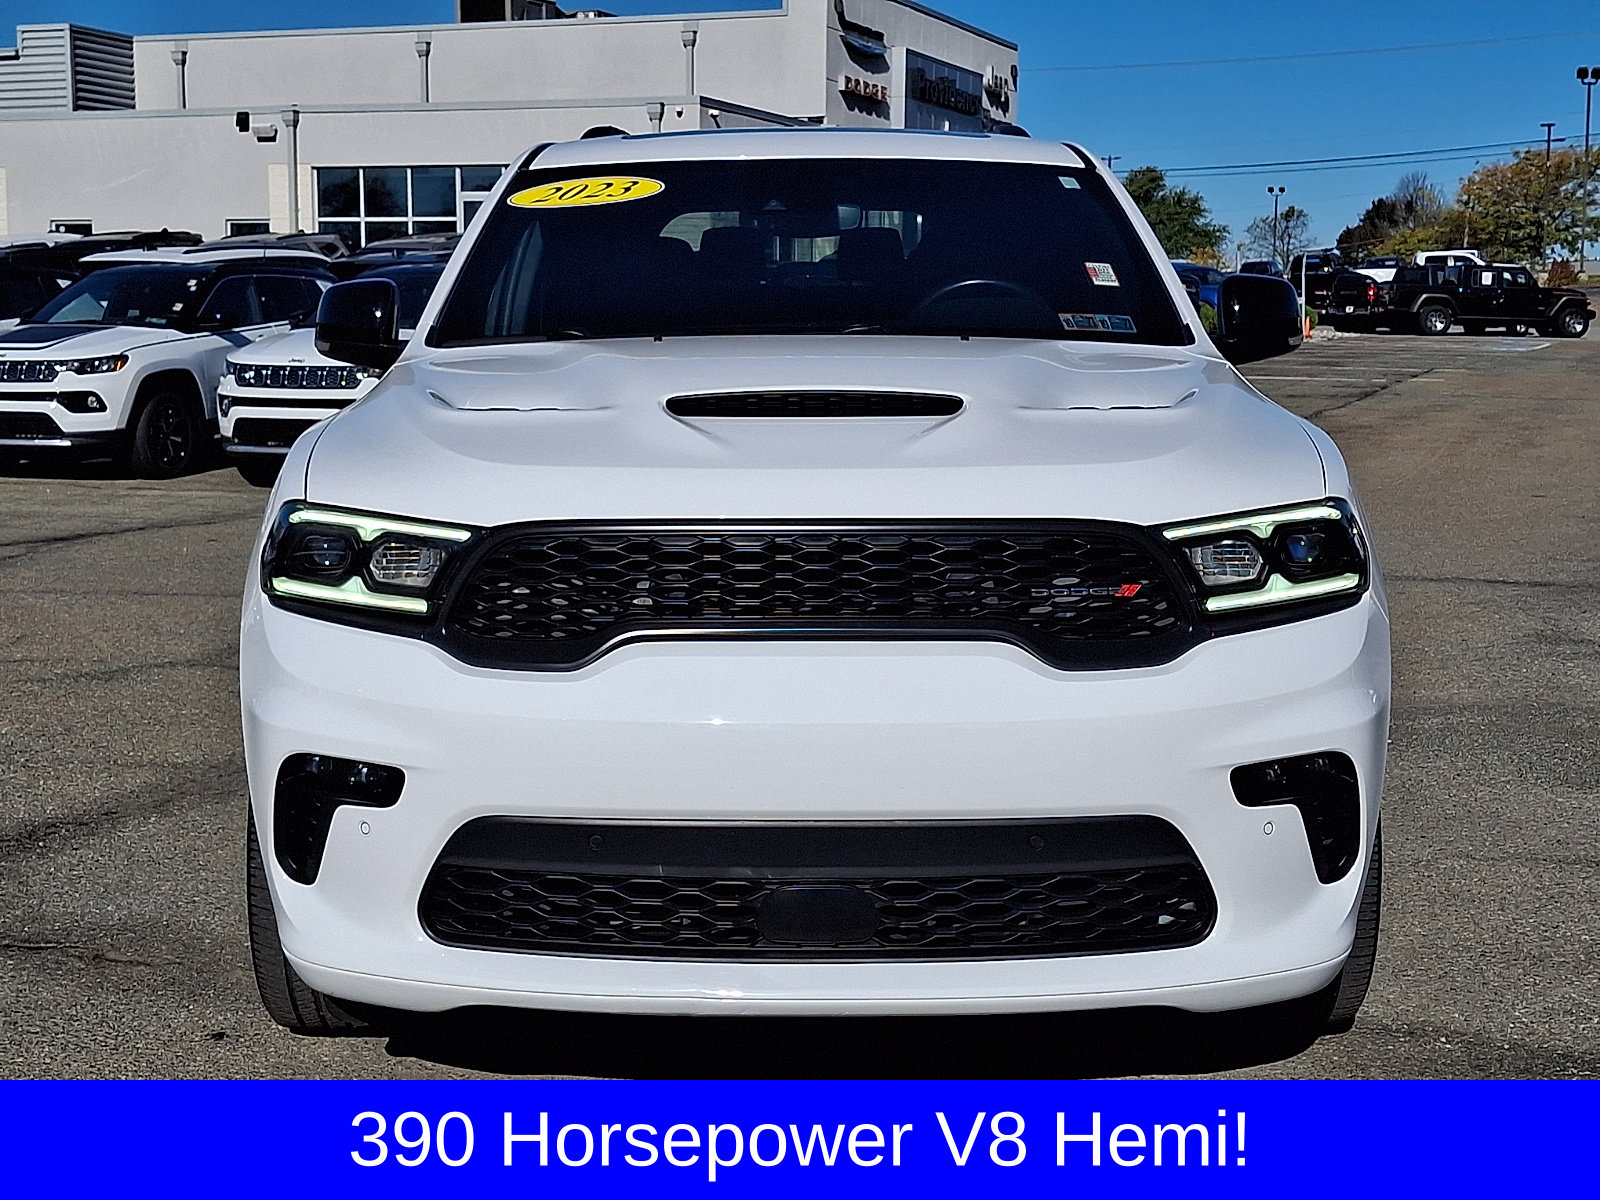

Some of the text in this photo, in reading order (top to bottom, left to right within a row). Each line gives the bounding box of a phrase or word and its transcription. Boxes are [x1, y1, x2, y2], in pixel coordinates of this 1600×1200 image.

[838, 75, 888, 102] DODGE
[530, 181, 640, 204] 2023
[1031, 588, 1123, 597] DODGE
